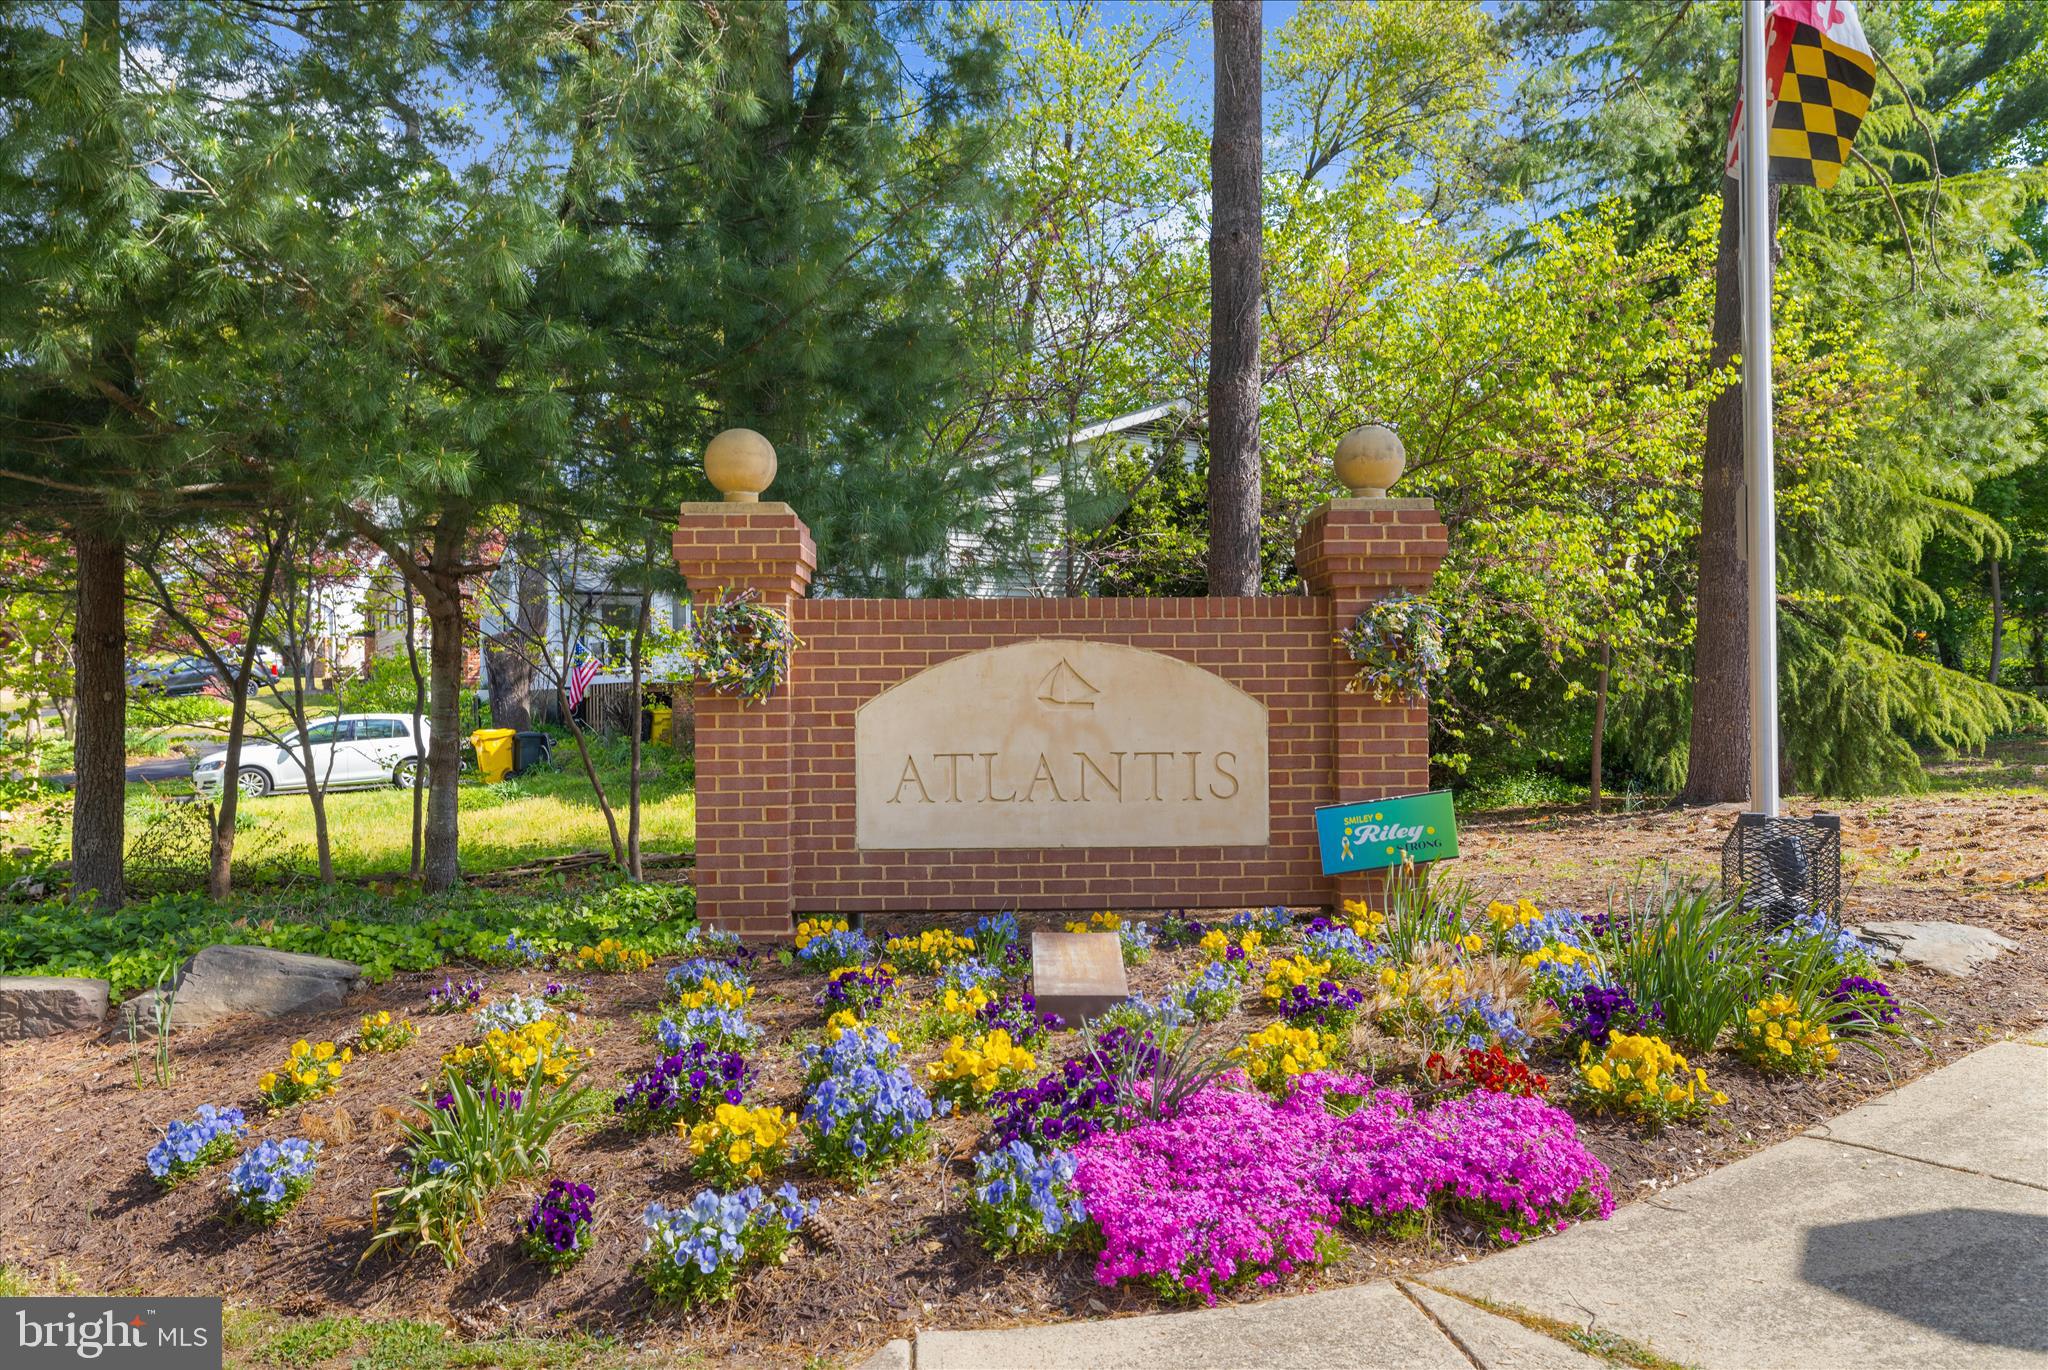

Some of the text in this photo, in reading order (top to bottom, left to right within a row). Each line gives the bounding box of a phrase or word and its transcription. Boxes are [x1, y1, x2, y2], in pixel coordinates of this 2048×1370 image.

[886, 751, 1240, 803] ATLANTIS
[1343, 814, 1374, 826] SMILEY
[1353, 823, 1425, 845] Riley
